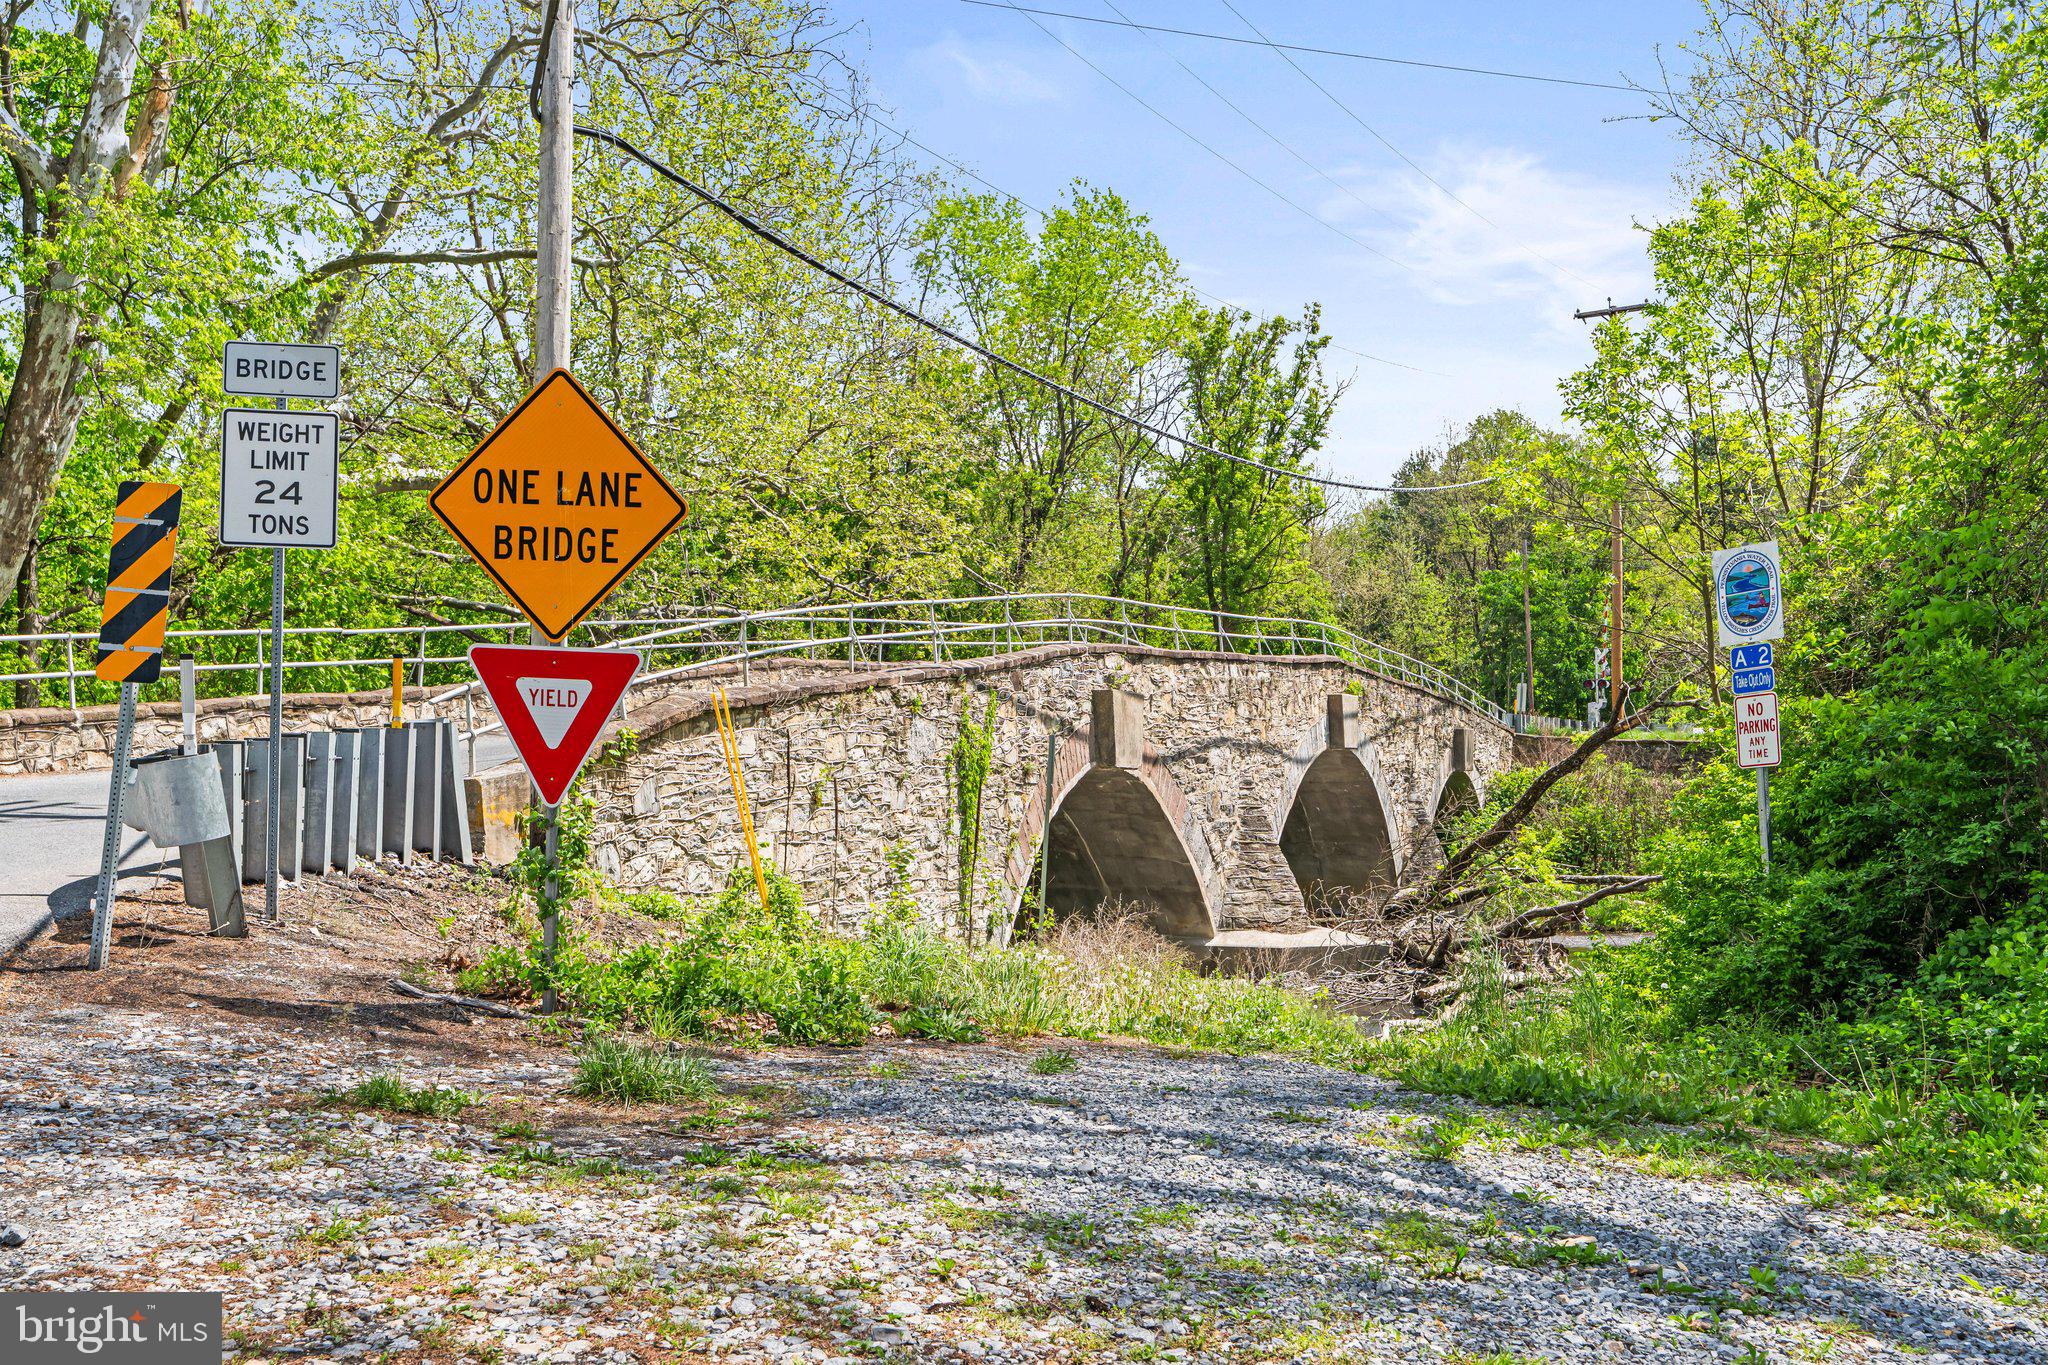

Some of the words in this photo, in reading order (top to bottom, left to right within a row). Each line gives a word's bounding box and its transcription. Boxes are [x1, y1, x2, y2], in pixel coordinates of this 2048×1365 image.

[236, 358, 327, 382] BRIDGE
[237, 421, 325, 445] WEIGHT
[250, 450, 310, 471] LIMIT
[254, 480, 303, 505] 24
[473, 468, 540, 505] ONE
[557, 471, 643, 508] LANE
[248, 514, 309, 536] TONS
[493, 525, 619, 564] BRIDGE
[1720, 554, 1746, 589] PENNSYLVANIA
[1747, 554, 1766, 563] WATER
[1765, 563, 1774, 579] TRAIL
[1749, 624, 1764, 632] CREEK
[1762, 610, 1775, 625] WATER
[1735, 649, 1747, 667] A
[1758, 646, 1769, 664] 2
[1735, 675, 1748, 688] Take
[1748, 673, 1758, 687] Out
[1759, 672, 1771, 688] Only
[528, 687, 579, 708] YIELD
[1747, 702, 1763, 716] NO
[1739, 717, 1775, 735] PARKING
[1749, 737, 1766, 746] ANY
[1748, 748, 1769, 759] TIME
